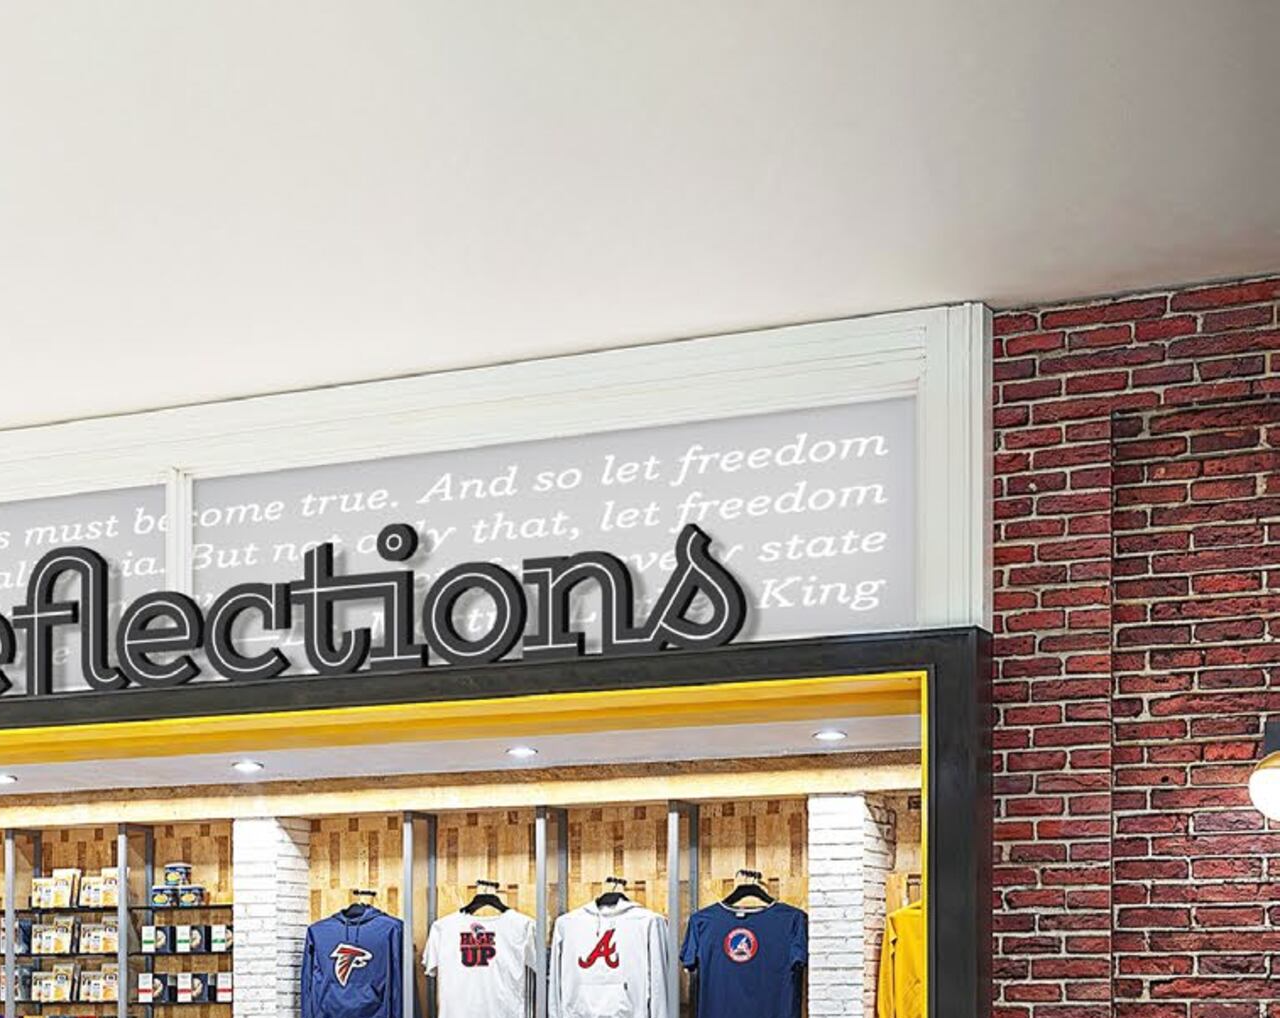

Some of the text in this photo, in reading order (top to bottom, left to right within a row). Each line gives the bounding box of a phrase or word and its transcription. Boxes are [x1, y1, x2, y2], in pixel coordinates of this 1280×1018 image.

[24, 514, 119, 545] must
[301, 488, 399, 517] true.
[416, 466, 519, 505] And
[532, 465, 582, 492] so
[600, 454, 661, 485] let
[670, 432, 890, 487] freedom
[471, 510, 579, 543] that,
[600, 502, 661, 533] let
[670, 480, 890, 533] freedom
[758, 530, 888, 562] state
[757, 576, 886, 612] King
[460, 946, 496, 968] UP
